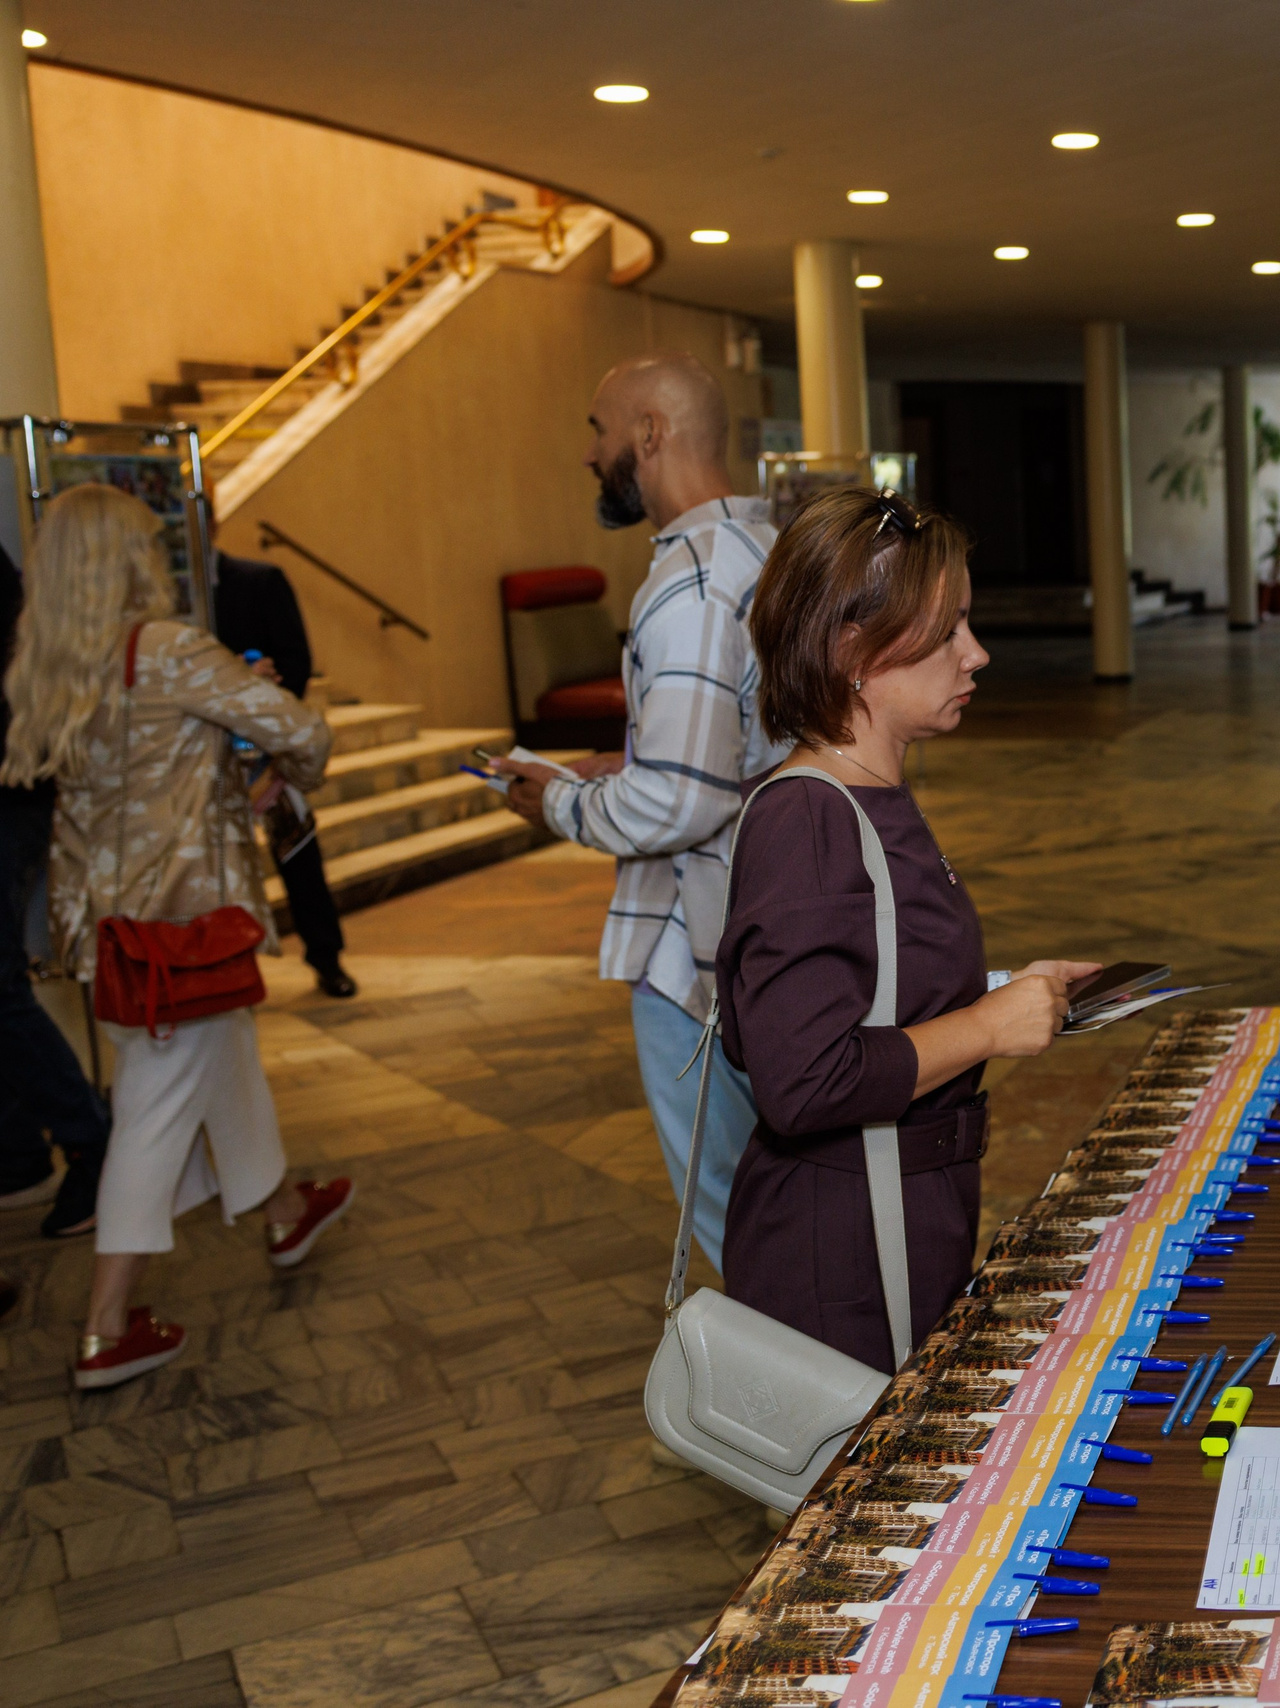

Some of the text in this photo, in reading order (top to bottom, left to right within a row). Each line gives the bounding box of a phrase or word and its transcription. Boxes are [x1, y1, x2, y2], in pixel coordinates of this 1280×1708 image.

[1045, 1419, 1065, 1452] «Авторский
[1080, 1432, 1099, 1464] «Пстор»
[949, 1511, 970, 1543] «Soloviev
[990, 1512, 1013, 1554] «Авторский
[1028, 1529, 1049, 1563] «Протор
[917, 1560, 942, 1595] «Soloviev
[890, 1612, 911, 1648] «Soloviev
[936, 1612, 959, 1659] «Авторский
[965, 1637, 983, 1674] Ульяновск
[979, 1629, 1001, 1676] «Простор»
